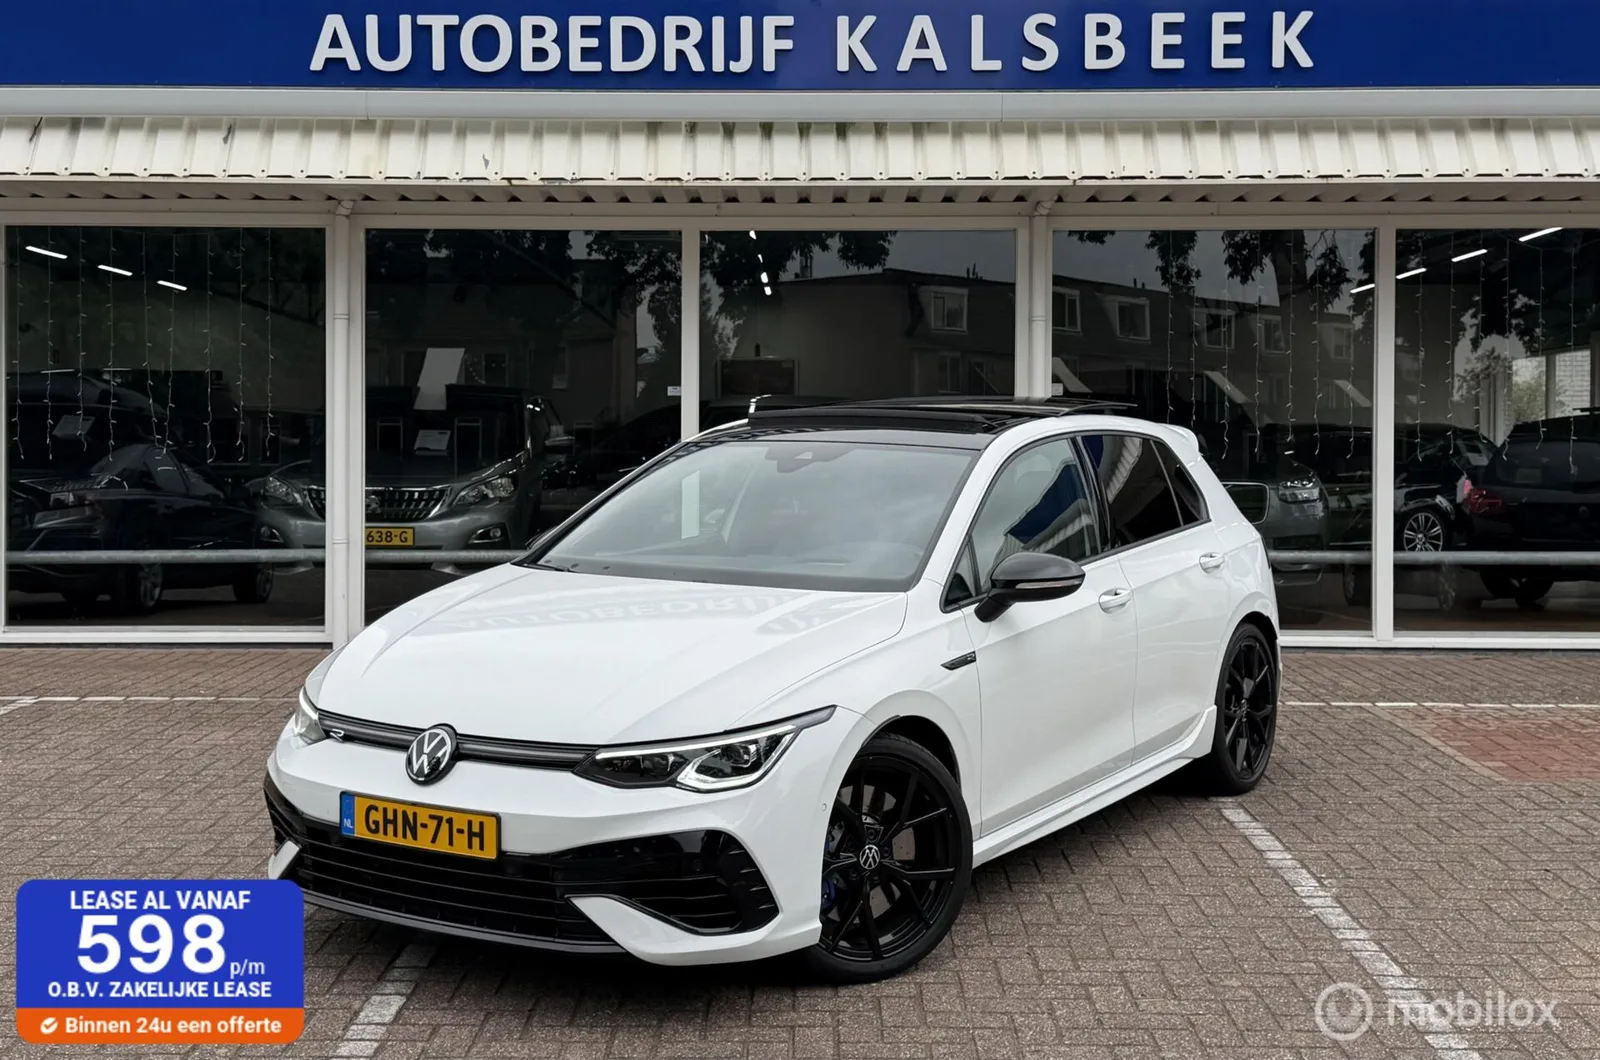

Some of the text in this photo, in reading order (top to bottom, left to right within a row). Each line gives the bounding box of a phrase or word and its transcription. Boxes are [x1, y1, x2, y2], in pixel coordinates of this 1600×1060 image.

[309, 10, 1314, 74] AUTOBEDRIJF KALSBEEK
[343, 818, 353, 829] NL
[364, 803, 485, 852] GHN-71-H
